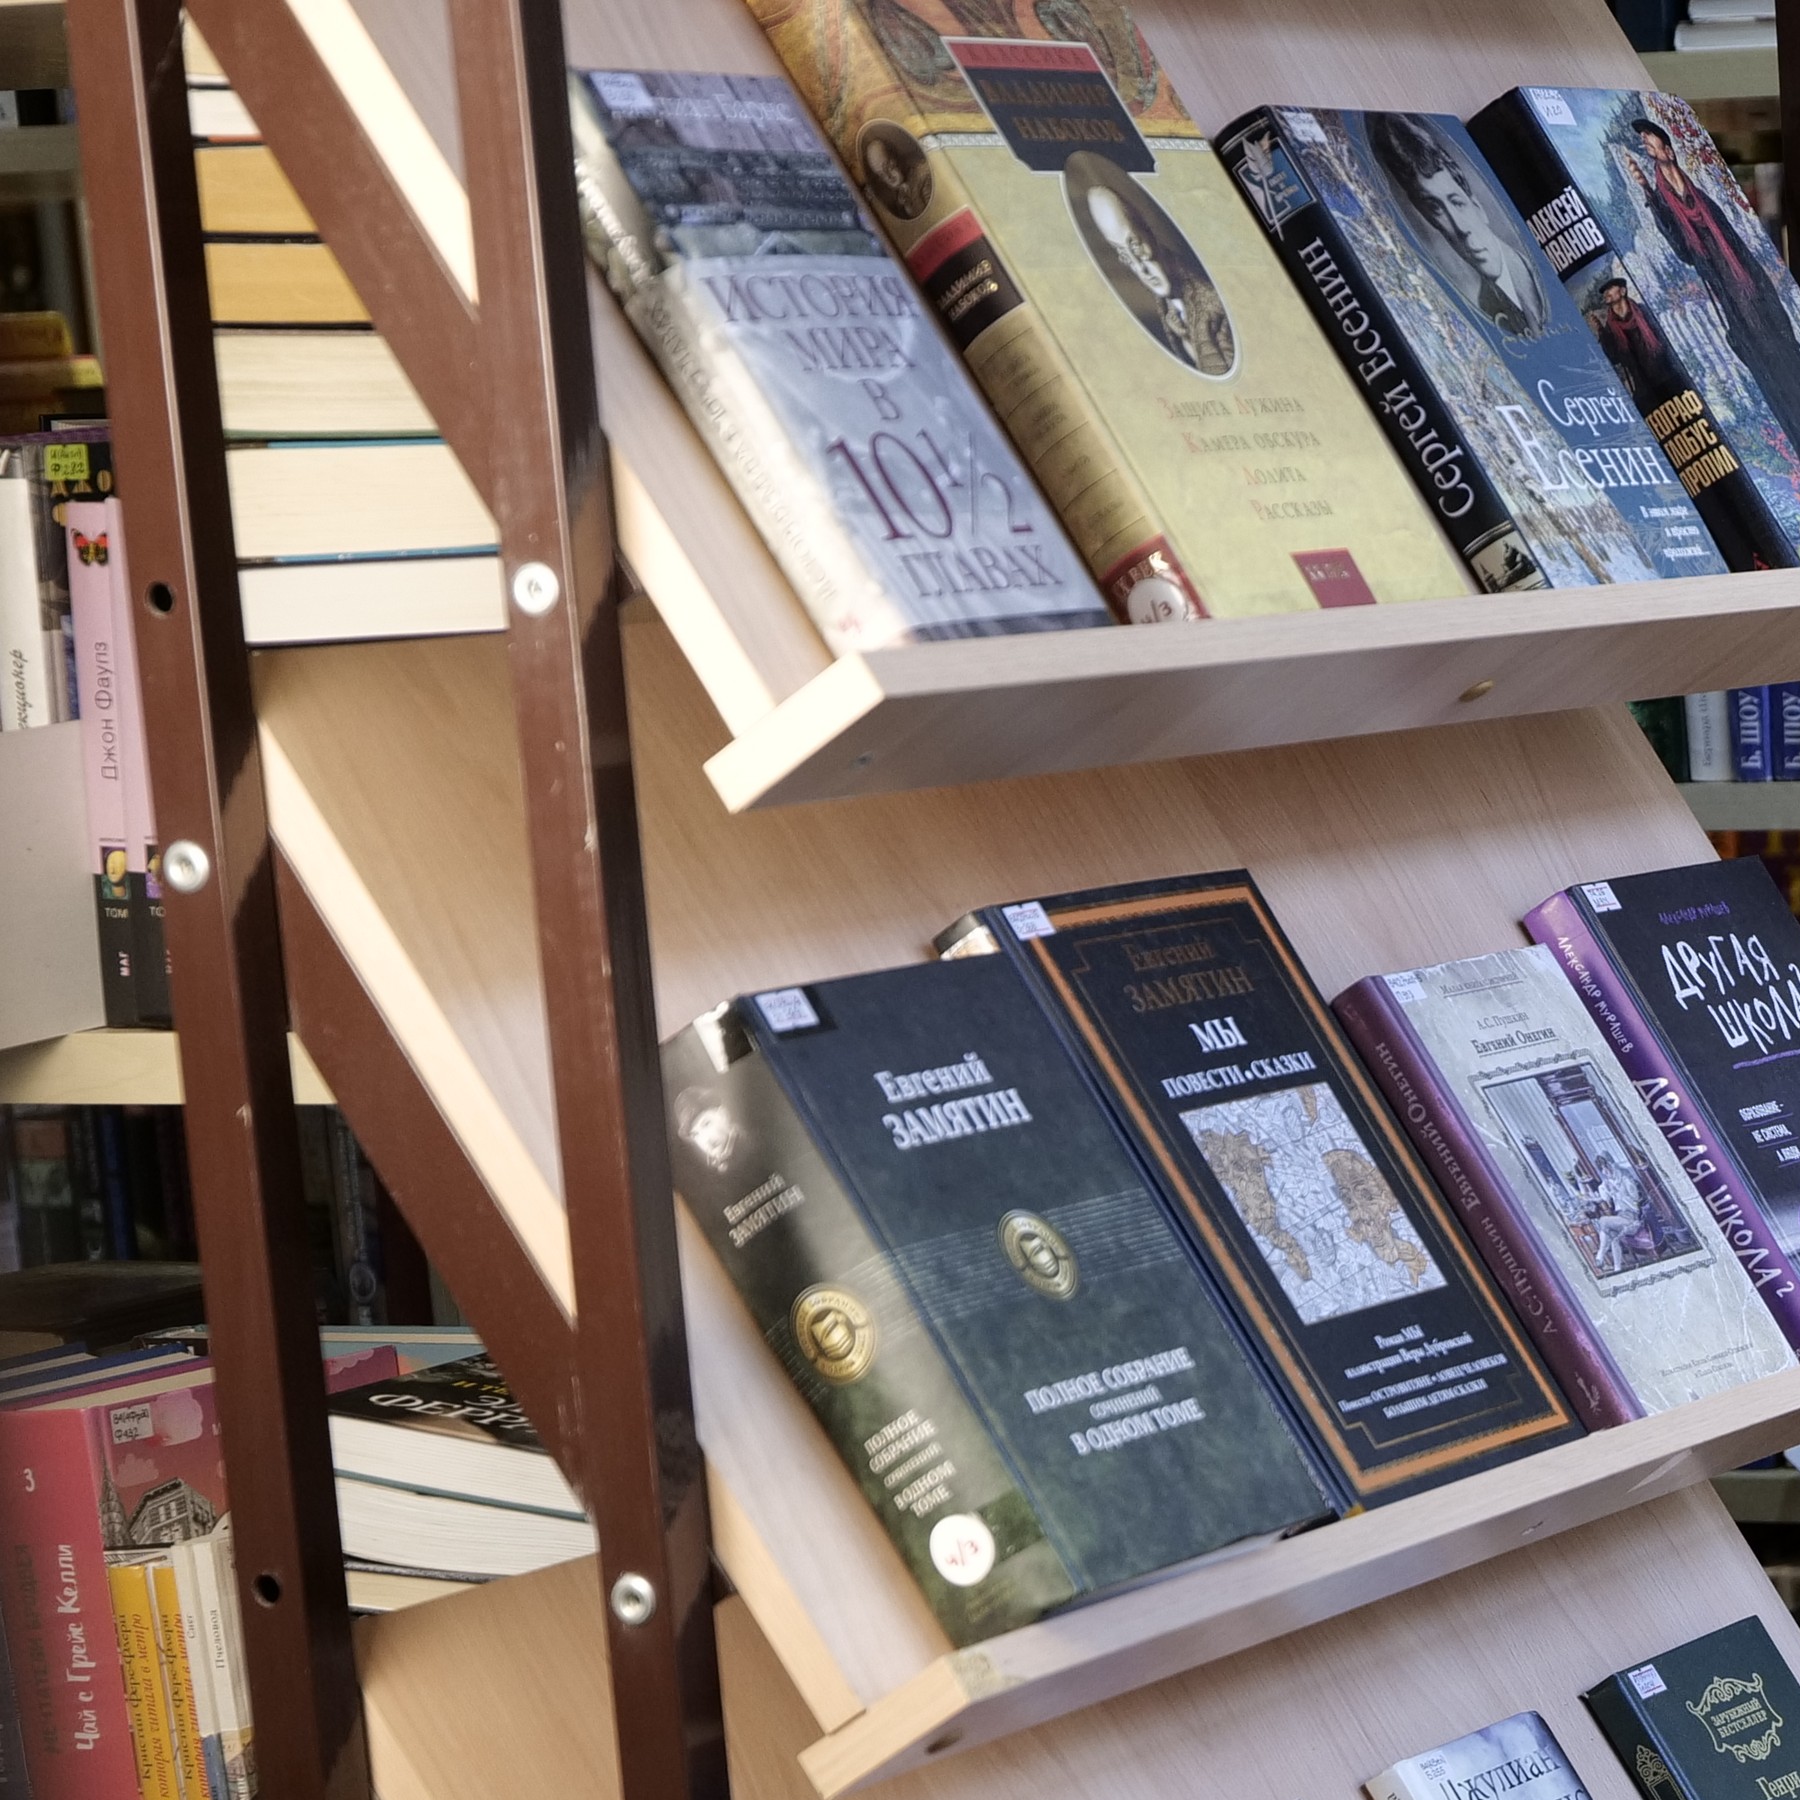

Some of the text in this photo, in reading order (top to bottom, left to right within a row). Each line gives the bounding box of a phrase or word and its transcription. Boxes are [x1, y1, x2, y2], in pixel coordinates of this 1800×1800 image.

[701, 275, 920, 322] ИСТОРИЯ
[785, 326, 917, 372] МИРА
[860, 378, 902, 421] В
[1537, 378, 1635, 436] Сергей
[1495, 405, 1672, 490] Есенин
[895, 544, 1064, 599] ГЛАВАХ
[93, 639, 120, 782] Джон Фаулз
[1123, 966, 1256, 1013] ЗАМЯТИН
[1661, 933, 1781, 1010] ДРУГАЯ
[1188, 1015, 1248, 1053] МЫ
[873, 1051, 995, 1103] Евгений
[881, 1087, 1034, 1151] ЗАМЯТИН
[1557, 935, 1603, 999] АЛЕКСАНДР
[1632, 1076, 1718, 1185] ДРУГАЯ
[1706, 1183, 1784, 1290] ШКОЛА
[722, 1173, 788, 1225] Евгений
[728, 1185, 806, 1249] ЗАМЯТИН
[1022, 1345, 1198, 1415] ПОЛНОЕ СОБРАНИЕ
[863, 1409, 919, 1454] ПОЛНОЕ
[1083, 1414, 1150, 1453] ОДНОМ
[57, 1542, 76, 1616] Келли
[208, 1608, 226, 1669] Пчеловод
